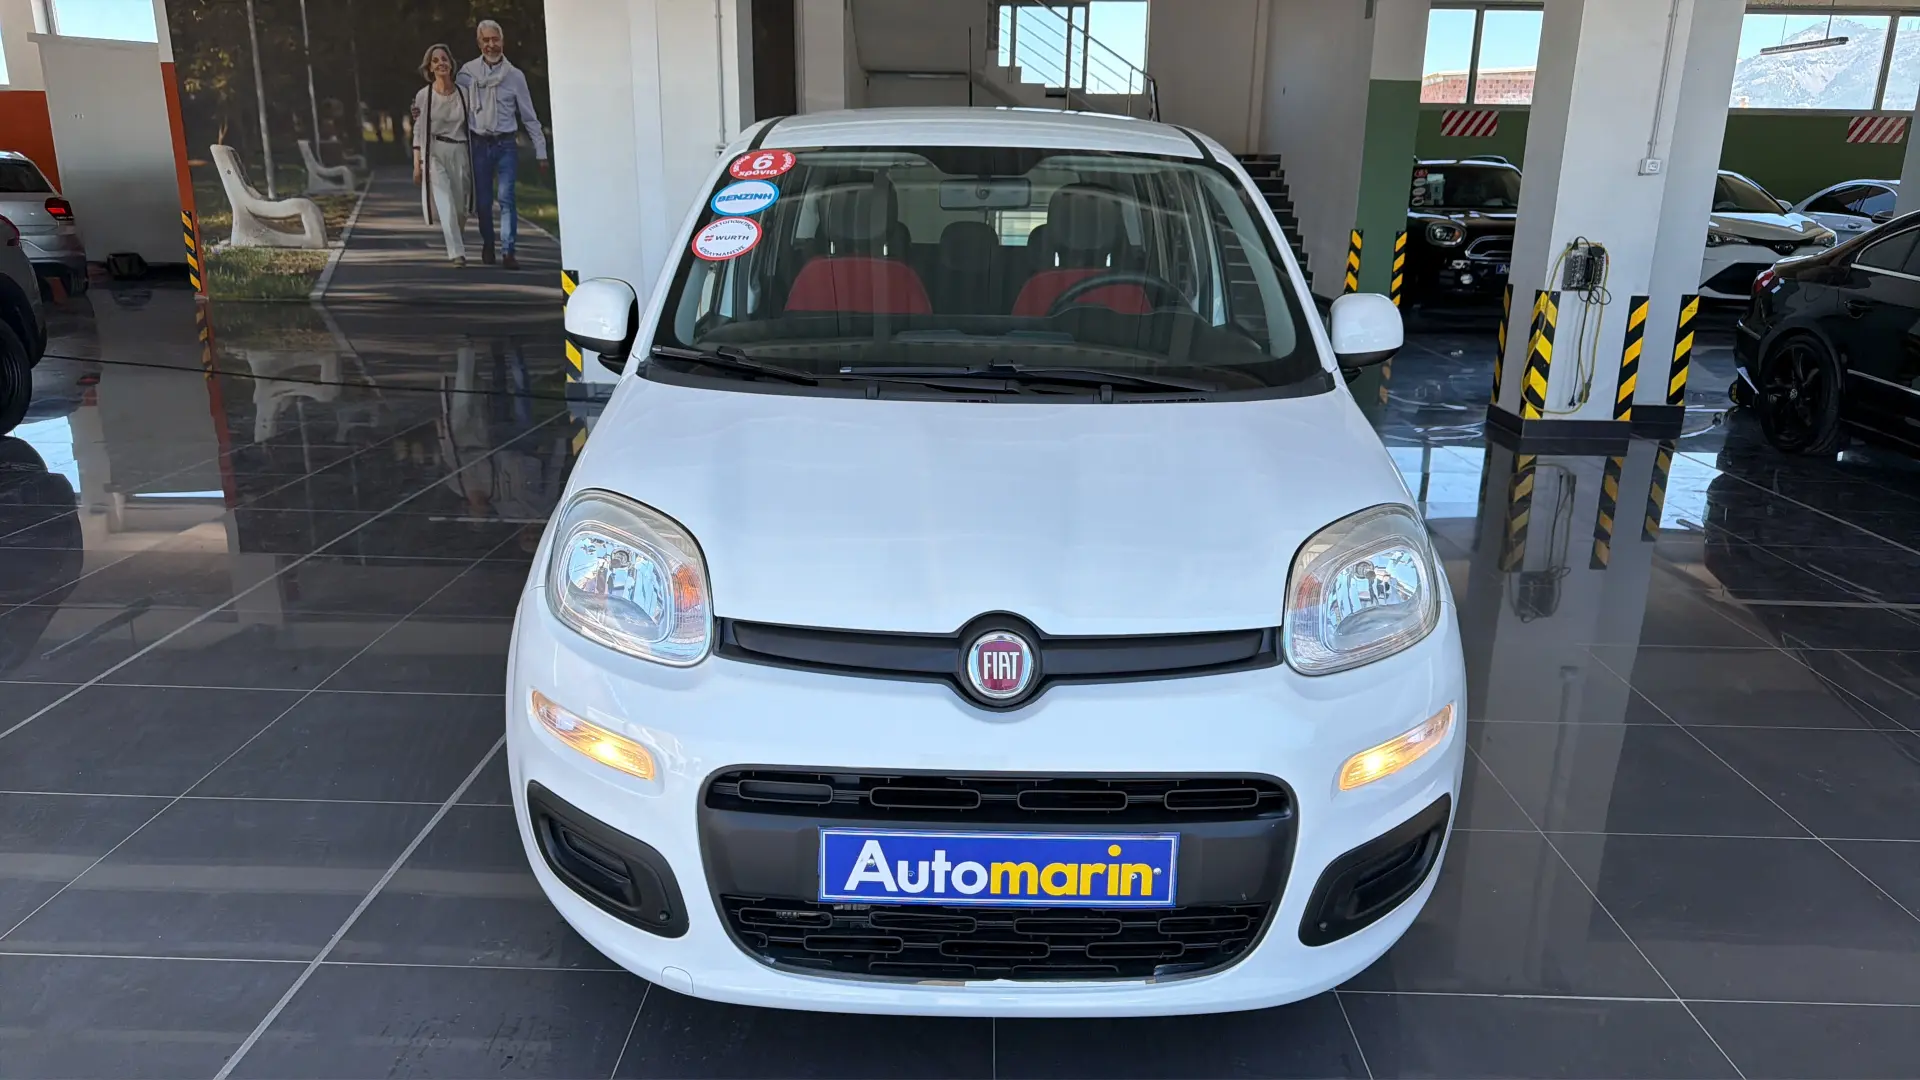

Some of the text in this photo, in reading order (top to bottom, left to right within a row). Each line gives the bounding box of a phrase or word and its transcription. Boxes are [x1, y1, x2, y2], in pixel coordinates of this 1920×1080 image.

[753, 155, 774, 170] 6
[983, 651, 1020, 680] FIAT
[843, 840, 1153, 897] Automarin
